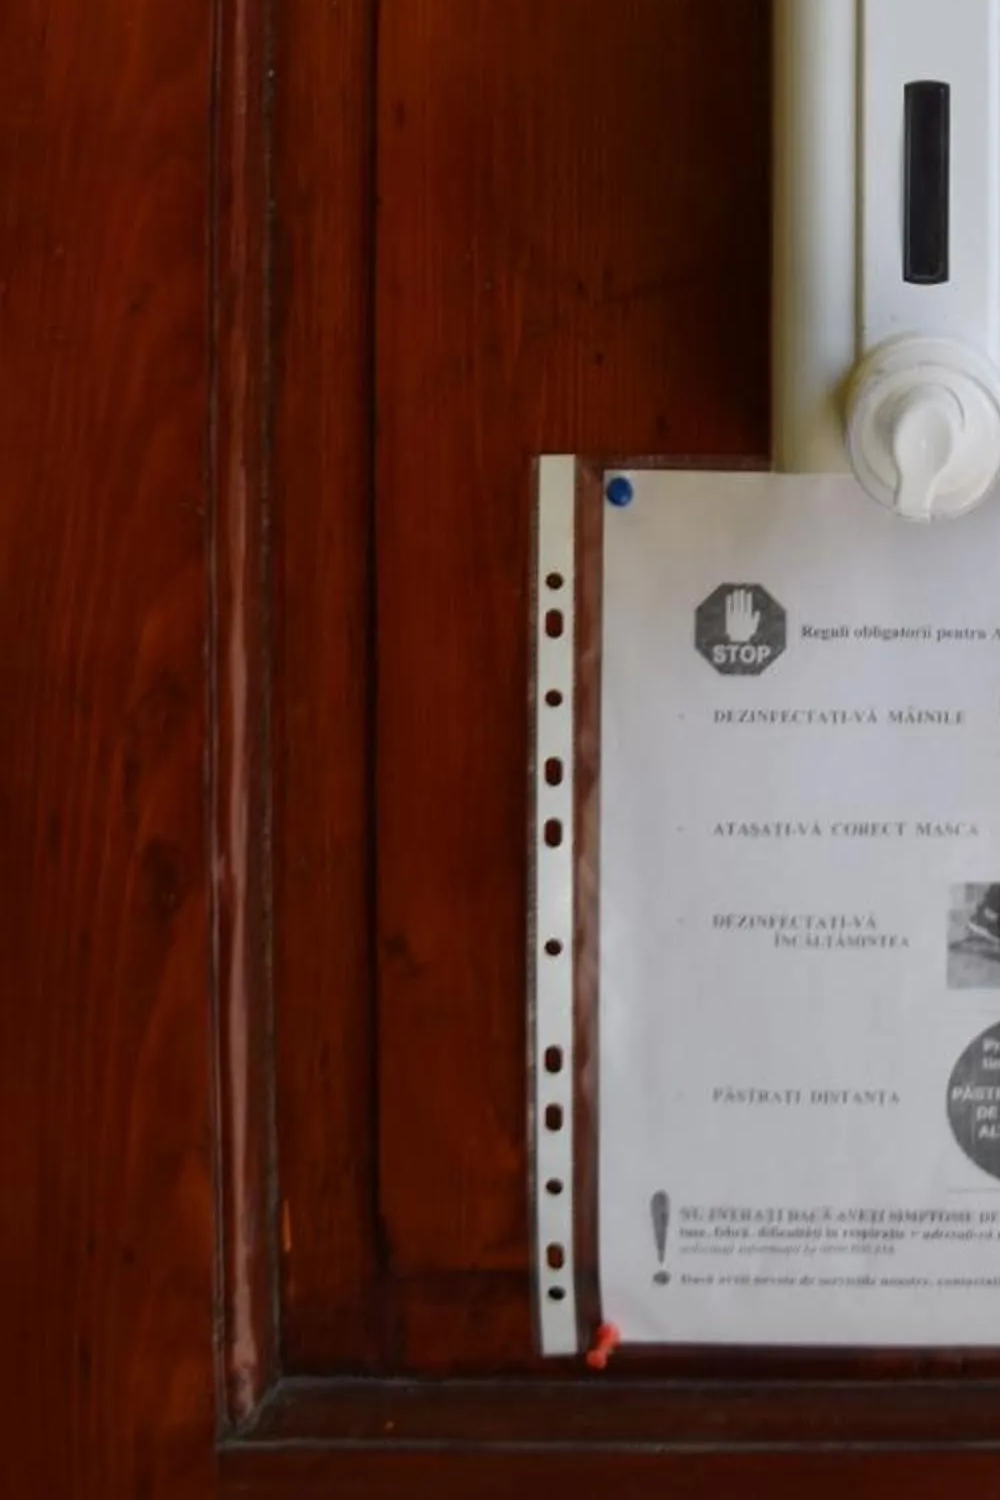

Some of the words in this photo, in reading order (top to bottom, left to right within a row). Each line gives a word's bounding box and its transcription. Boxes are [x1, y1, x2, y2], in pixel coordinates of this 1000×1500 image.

[801, 624, 849, 643] Reguli
[853, 624, 931, 643] obligatorii
[936, 626, 986, 642] pentru
[713, 644, 771, 664] STOP
